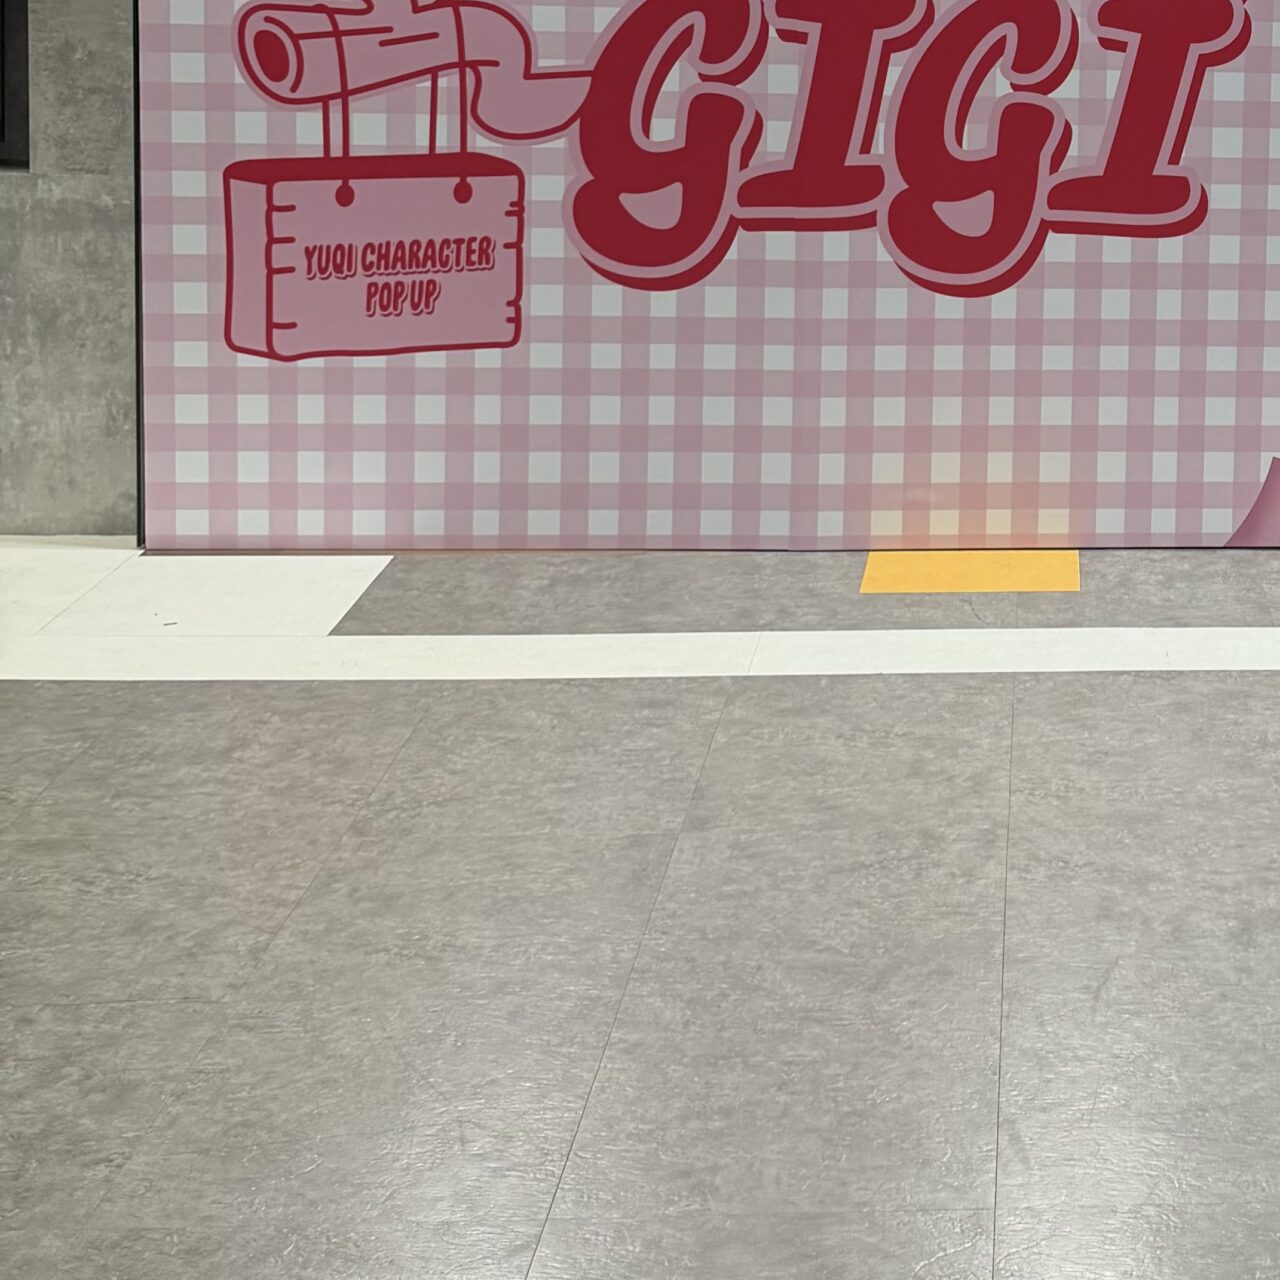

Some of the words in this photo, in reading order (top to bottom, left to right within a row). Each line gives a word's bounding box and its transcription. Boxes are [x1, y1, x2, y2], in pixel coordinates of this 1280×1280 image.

[304, 242, 358, 280] YUQI
[361, 235, 496, 276] CHARACTER
[365, 281, 408, 318] POP
[409, 278, 441, 315] UP
